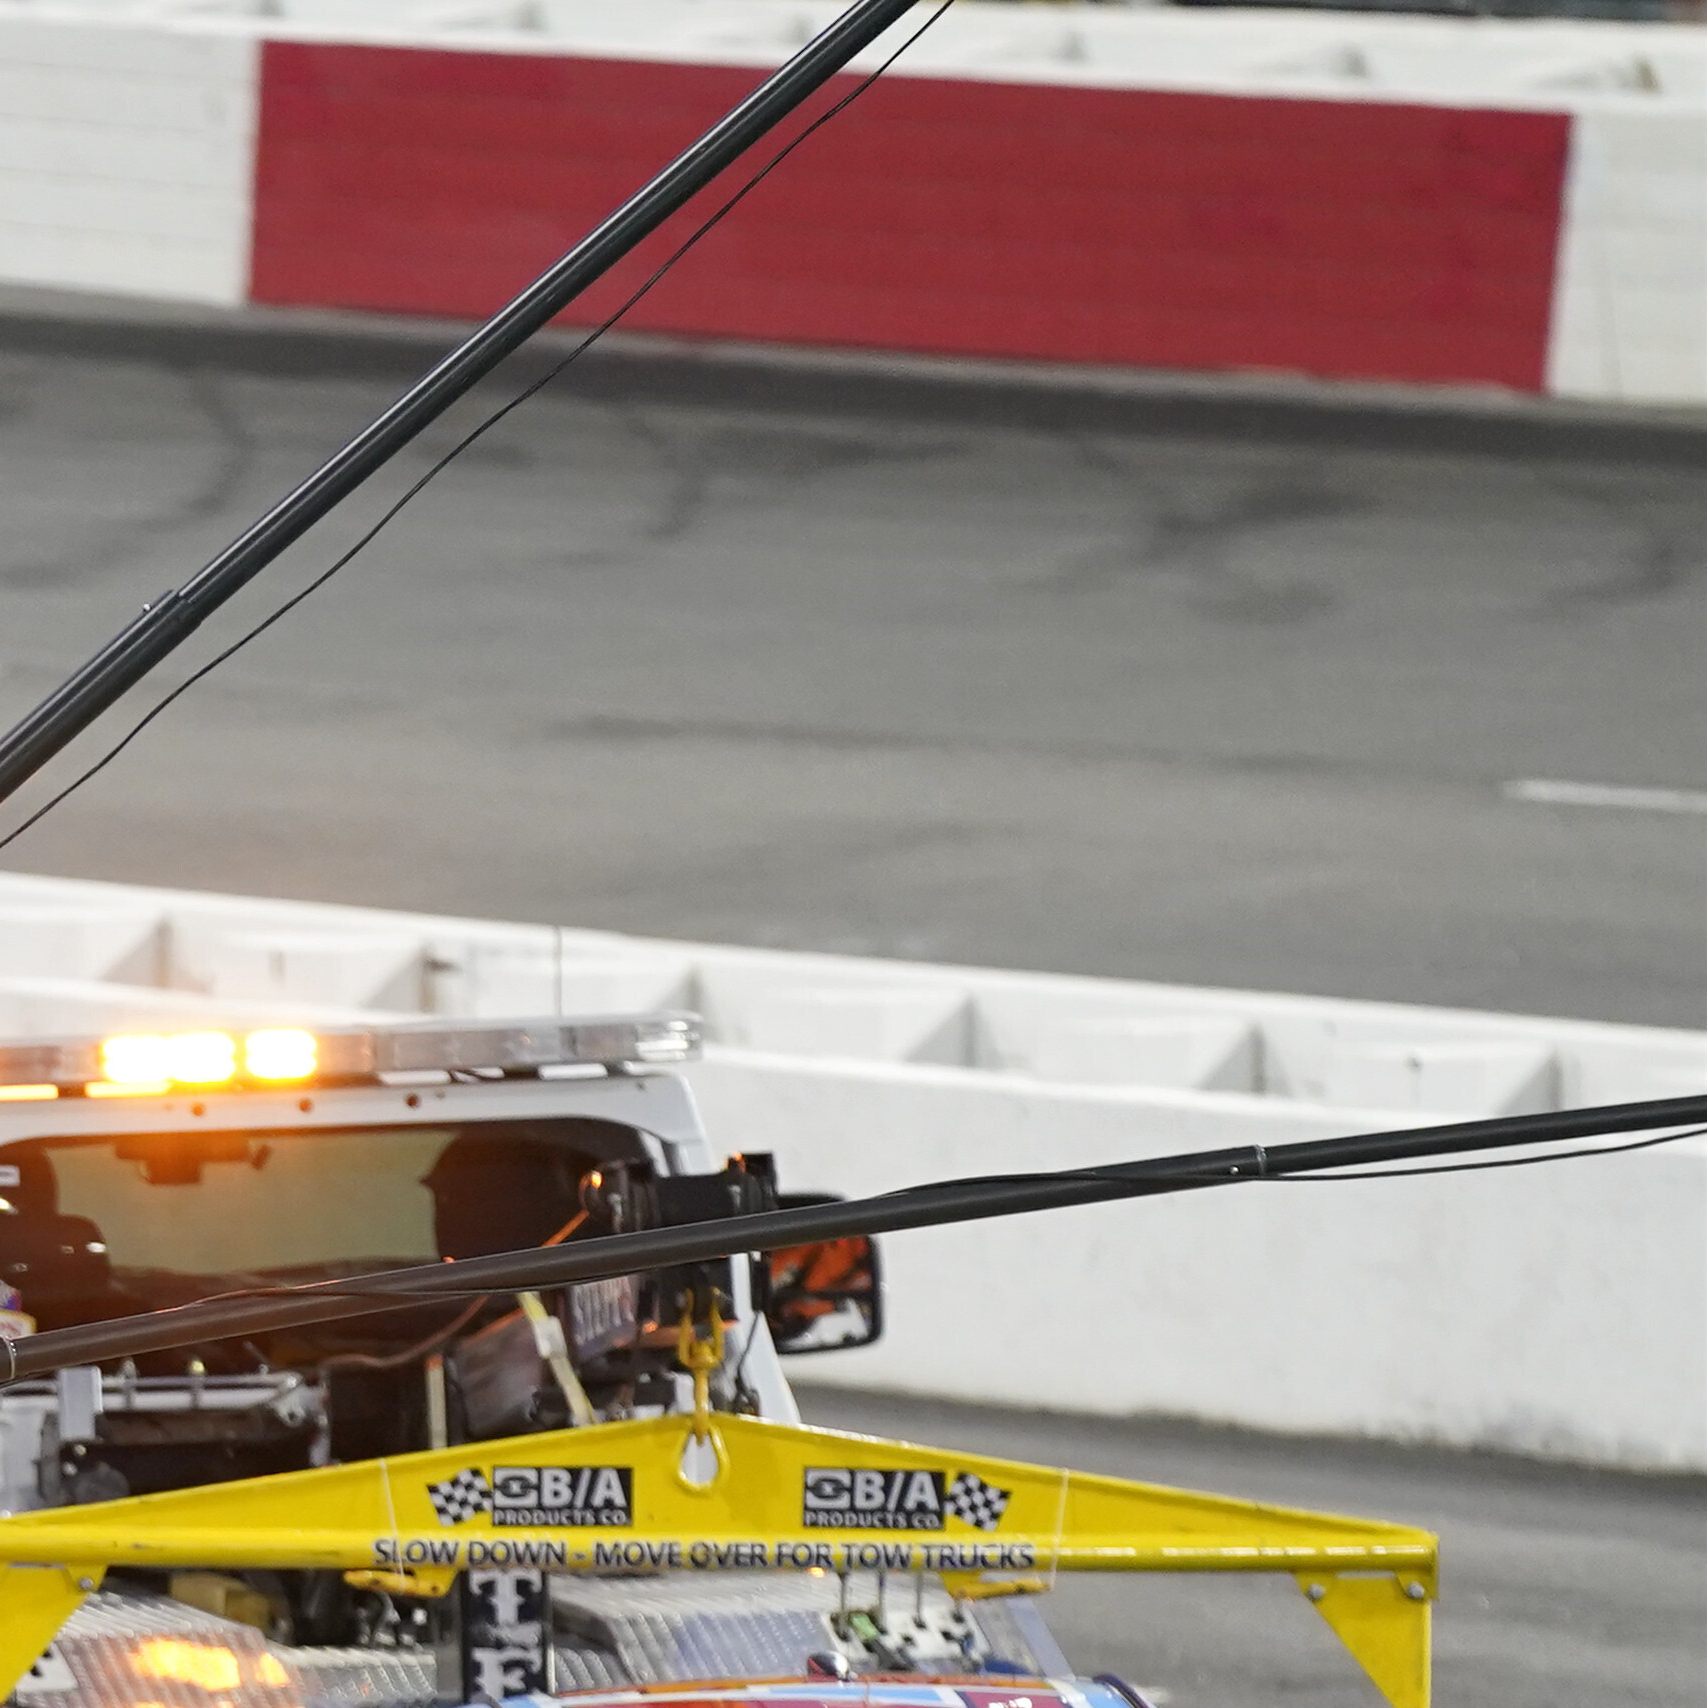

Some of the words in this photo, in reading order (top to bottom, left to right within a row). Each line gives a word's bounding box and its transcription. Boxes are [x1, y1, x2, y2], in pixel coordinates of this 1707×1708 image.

[540, 1467, 628, 1509] B/A
[854, 1470, 942, 1511] B/A
[494, 1510, 595, 1525] PRODUCTS
[804, 1511, 906, 1528] PRODUCTS
[374, 1538, 459, 1565] SLOW
[467, 1540, 569, 1565] DOWN
[594, 1541, 684, 1566] MOVE
[689, 1542, 768, 1567] OVER
[775, 1542, 834, 1568] FOR
[842, 1542, 913, 1568] TOW
[919, 1543, 1036, 1569] TRUCKS
